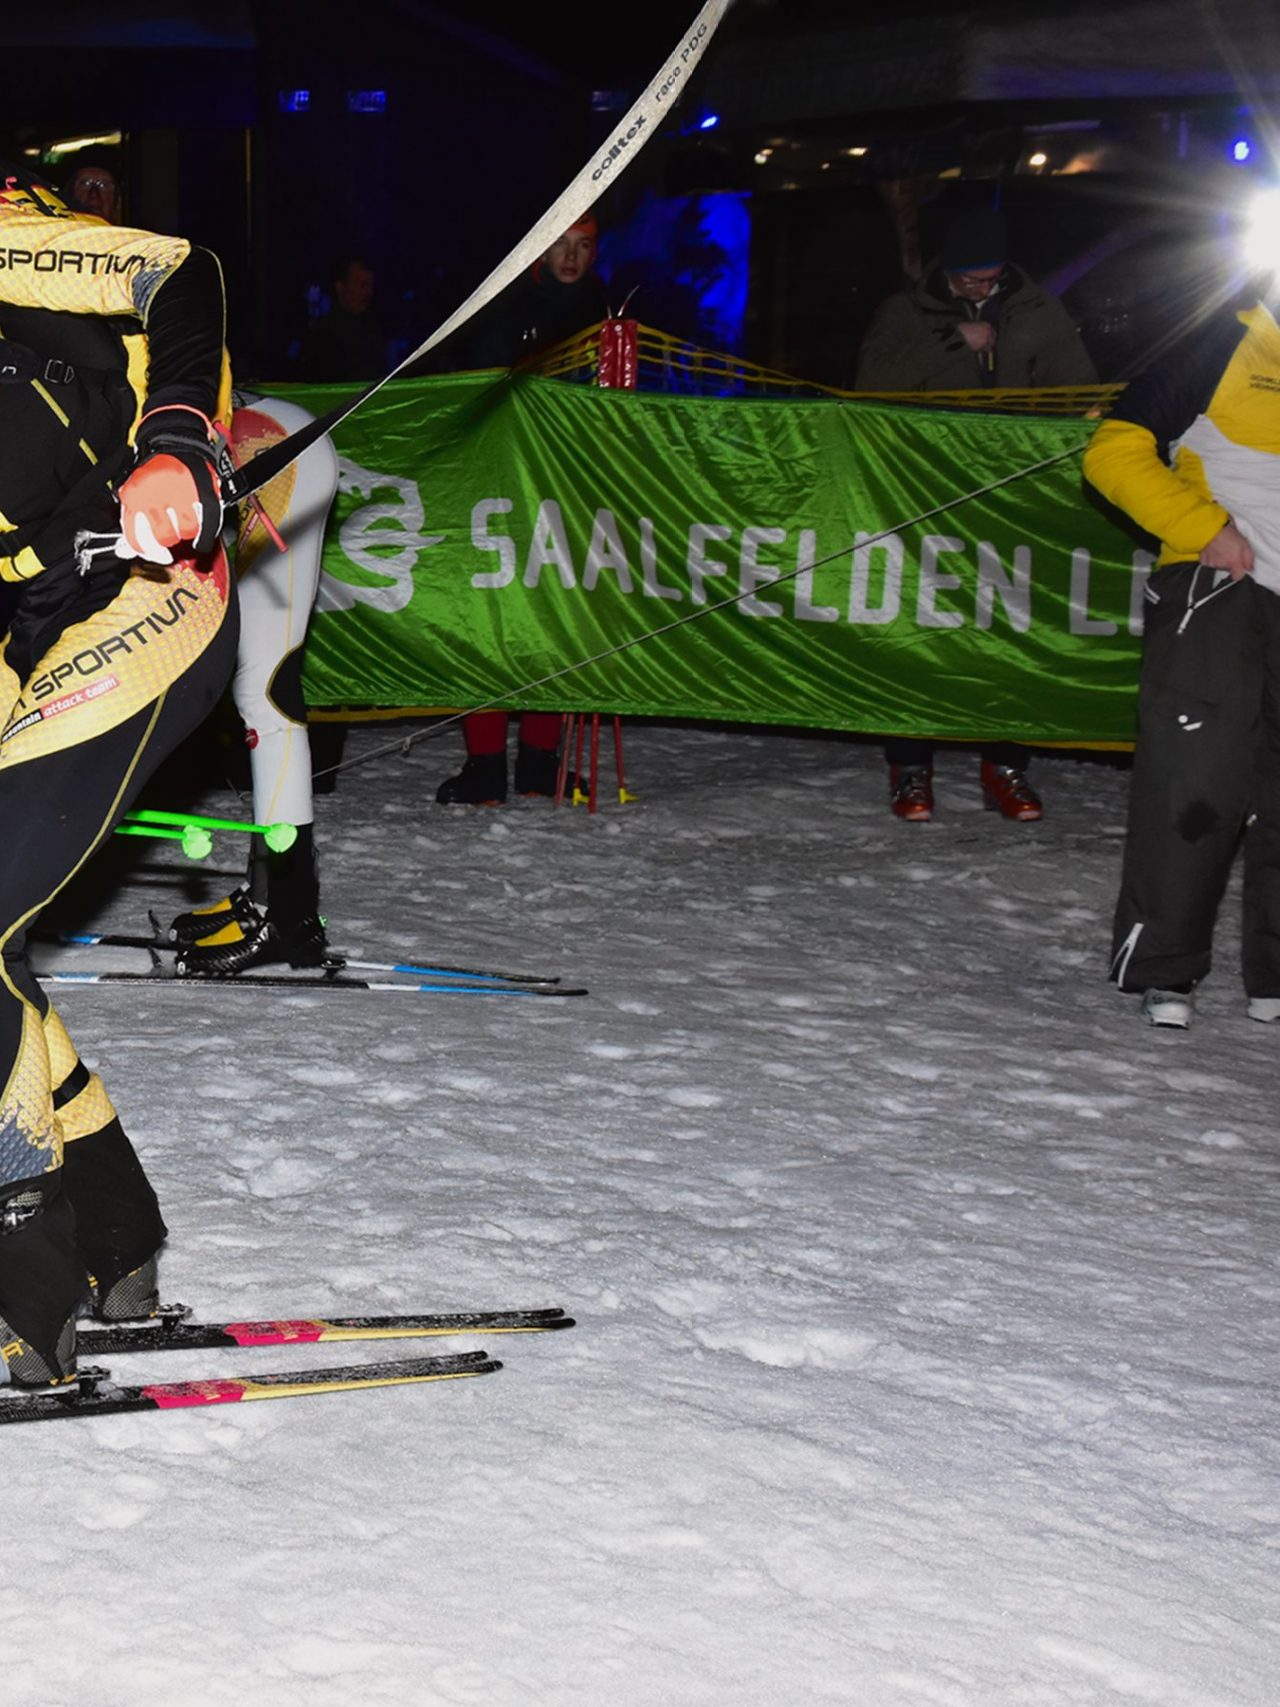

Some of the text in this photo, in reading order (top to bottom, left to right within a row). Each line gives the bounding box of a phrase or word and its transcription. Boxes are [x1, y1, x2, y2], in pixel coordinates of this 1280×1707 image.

[591, 23, 709, 182] colltex race PDG
[470, 498, 1032, 634] SAALFELDEN
[31, 587, 199, 701] SPORTIVA
[43, 692, 84, 718] attack
